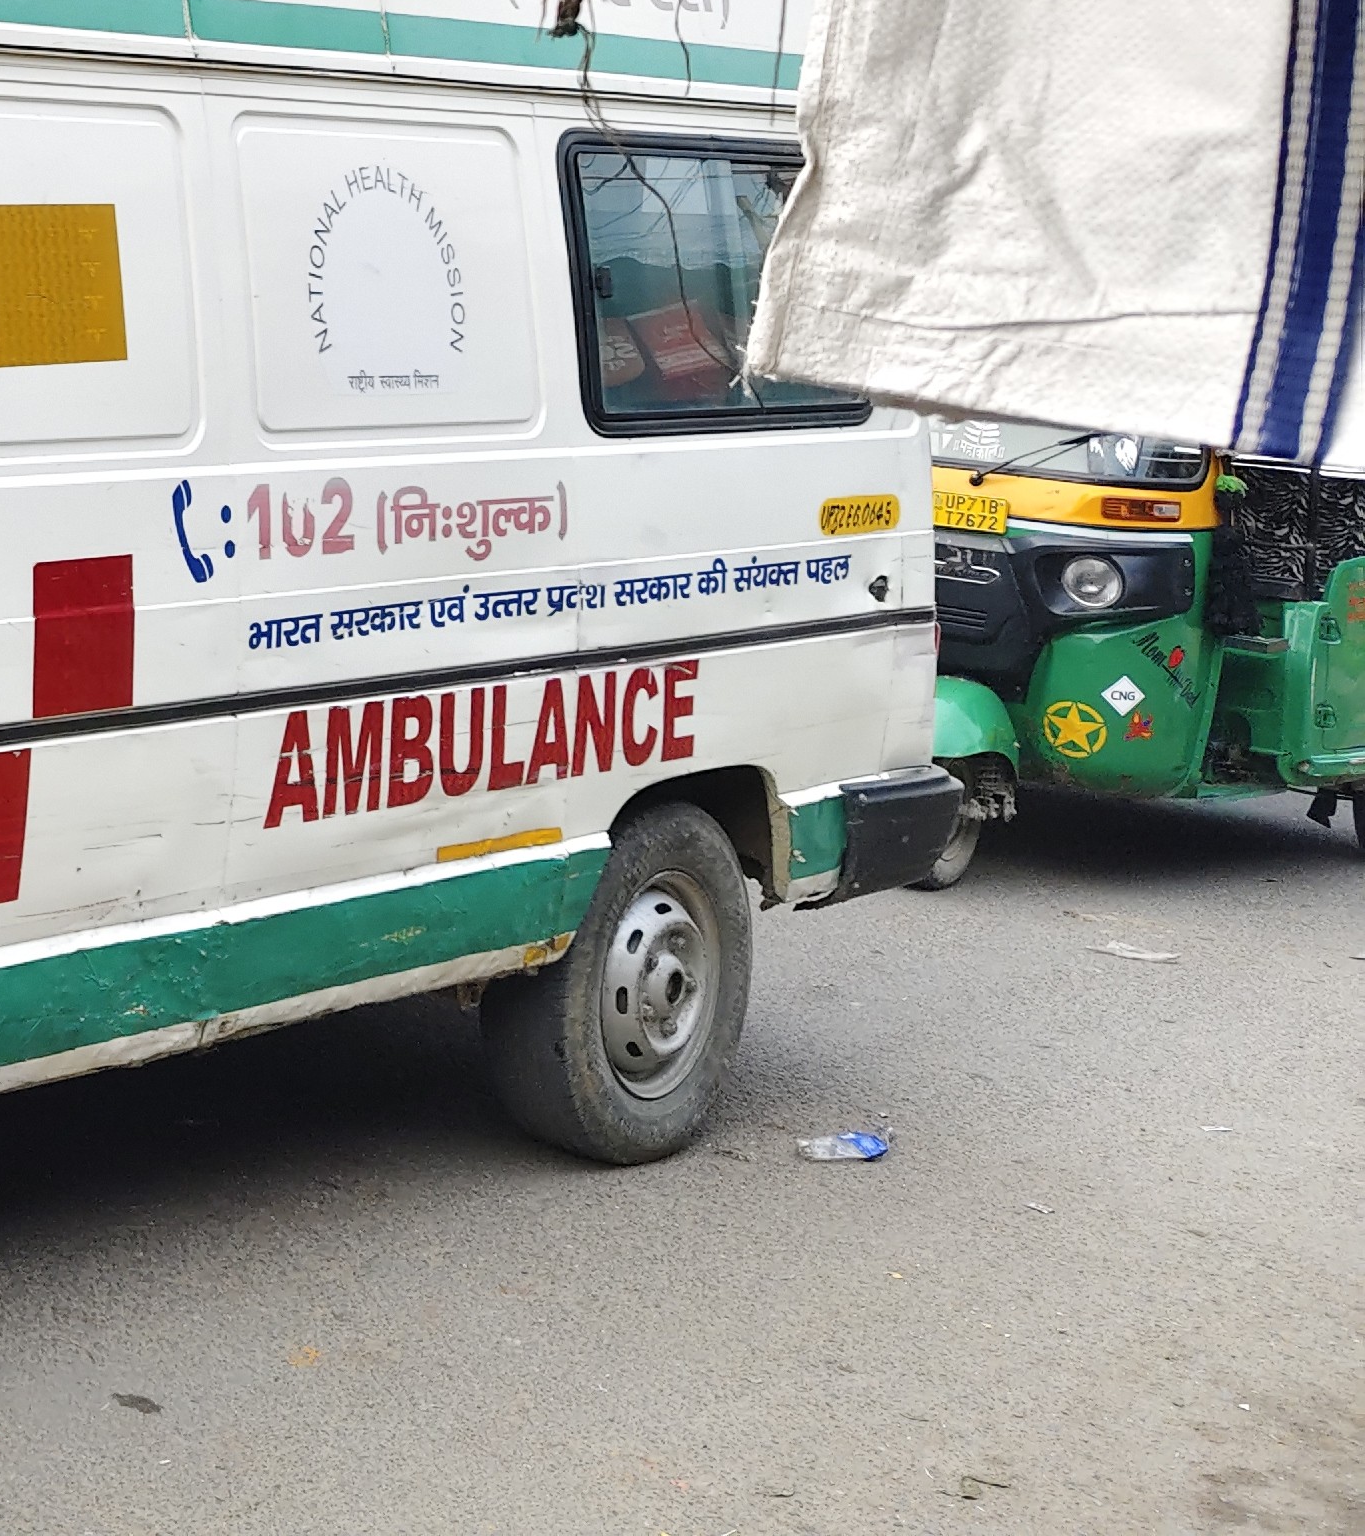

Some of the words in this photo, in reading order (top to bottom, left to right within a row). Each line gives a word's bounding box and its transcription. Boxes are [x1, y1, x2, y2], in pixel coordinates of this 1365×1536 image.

[307, 189, 348, 355] NATIONAL
[344, 165, 425, 213] HEALTH
[424, 206, 466, 354] MISSION
[346, 369, 376, 394] राष्ट्रीय
[412, 368, 441, 390] मिशन
[945, 495, 999, 515] UP71B
[945, 510, 999, 531] T7672
[248, 613, 323, 650] भारत
[329, 599, 424, 641] सरकार
[427, 583, 471, 629] एवं
[472, 587, 541, 622] उत्तर
[613, 571, 693, 607] सरकार
[697, 557, 728, 596] की
[805, 553, 853, 585] पहल
[1110, 690, 1136, 701] CNG
[263, 659, 700, 830] AMBULANCE
